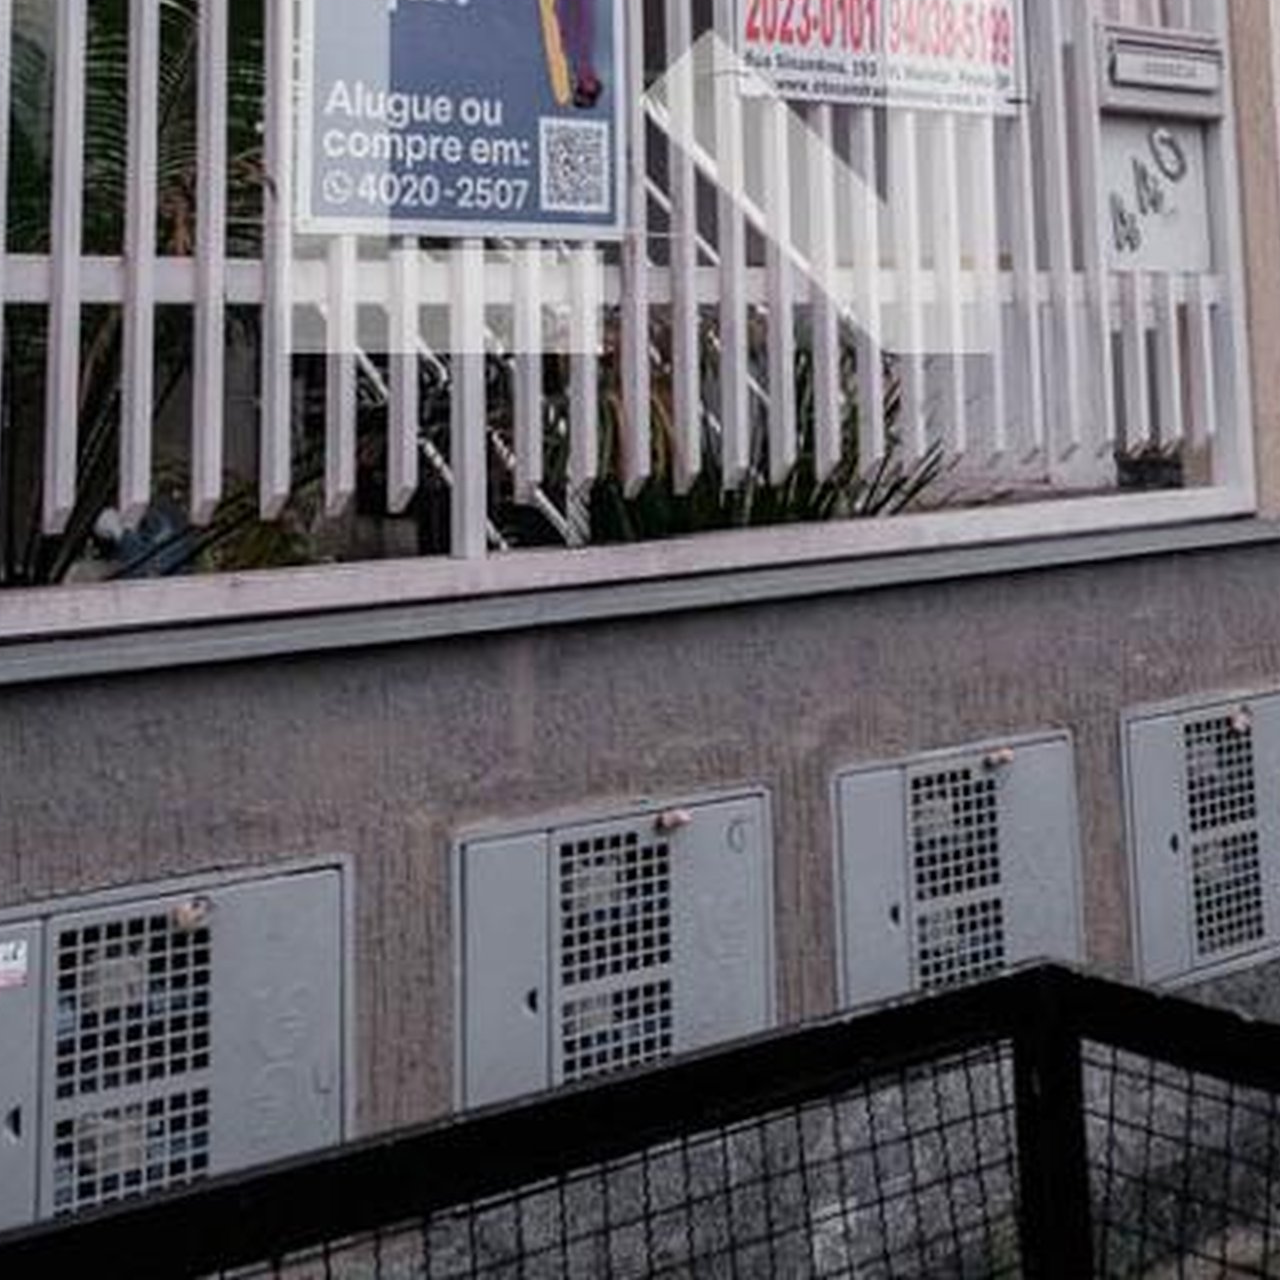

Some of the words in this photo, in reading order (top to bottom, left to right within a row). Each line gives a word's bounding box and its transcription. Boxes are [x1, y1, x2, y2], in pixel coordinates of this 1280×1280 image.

[323, 79, 452, 129] Alugue
[459, 96, 504, 127] ou
[322, 128, 463, 168] compre
[468, 135, 532, 167] em:
[358, 173, 531, 210] 4020-2507
